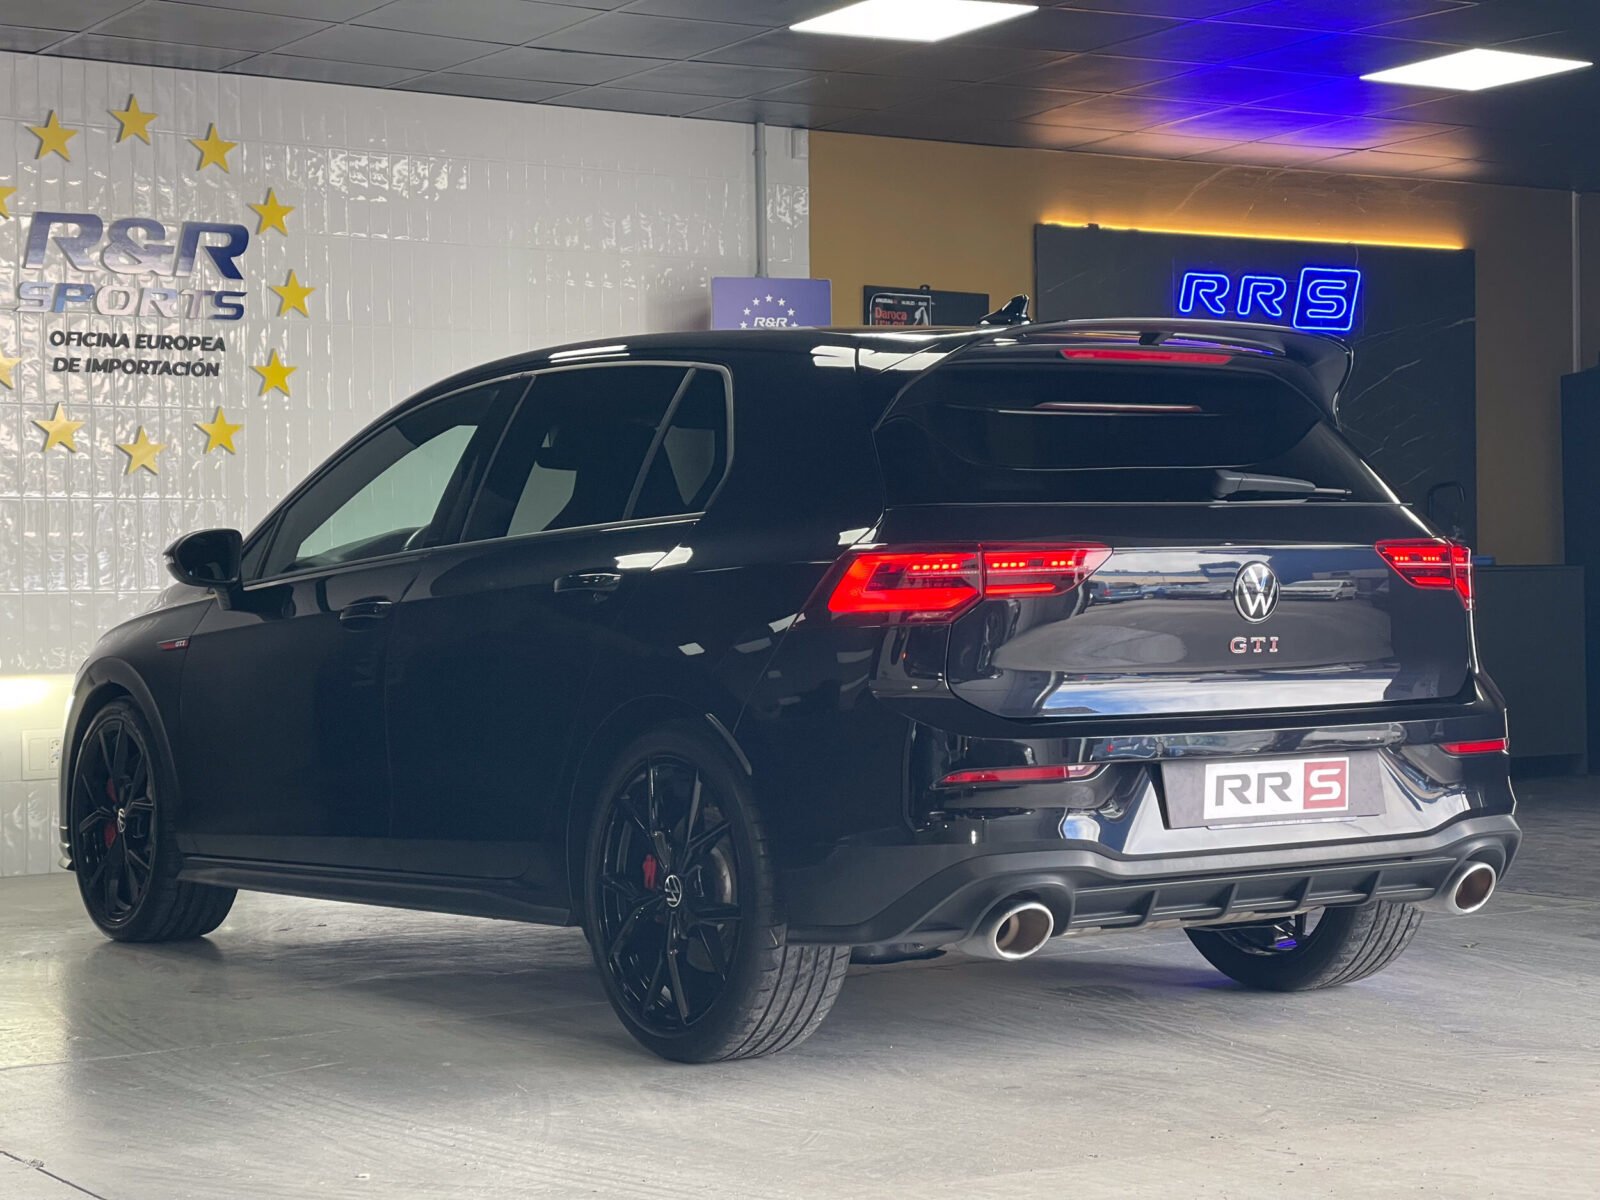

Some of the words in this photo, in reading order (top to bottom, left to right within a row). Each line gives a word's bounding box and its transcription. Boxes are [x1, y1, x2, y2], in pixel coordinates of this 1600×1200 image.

[22, 211, 249, 280] R&R
[16, 281, 247, 321] SPORTS
[1179, 271, 1350, 320] RRS
[753, 316, 788, 328] R&R
[875, 306, 908, 321] Daroca
[50, 330, 130, 349] OFICINA
[134, 334, 226, 352] EUROPEA
[52, 357, 82, 373] DE
[85, 358, 220, 377] IMPORTACIÓN
[1229, 636, 1279, 654] GTI
[1214, 768, 1342, 807] RRS
